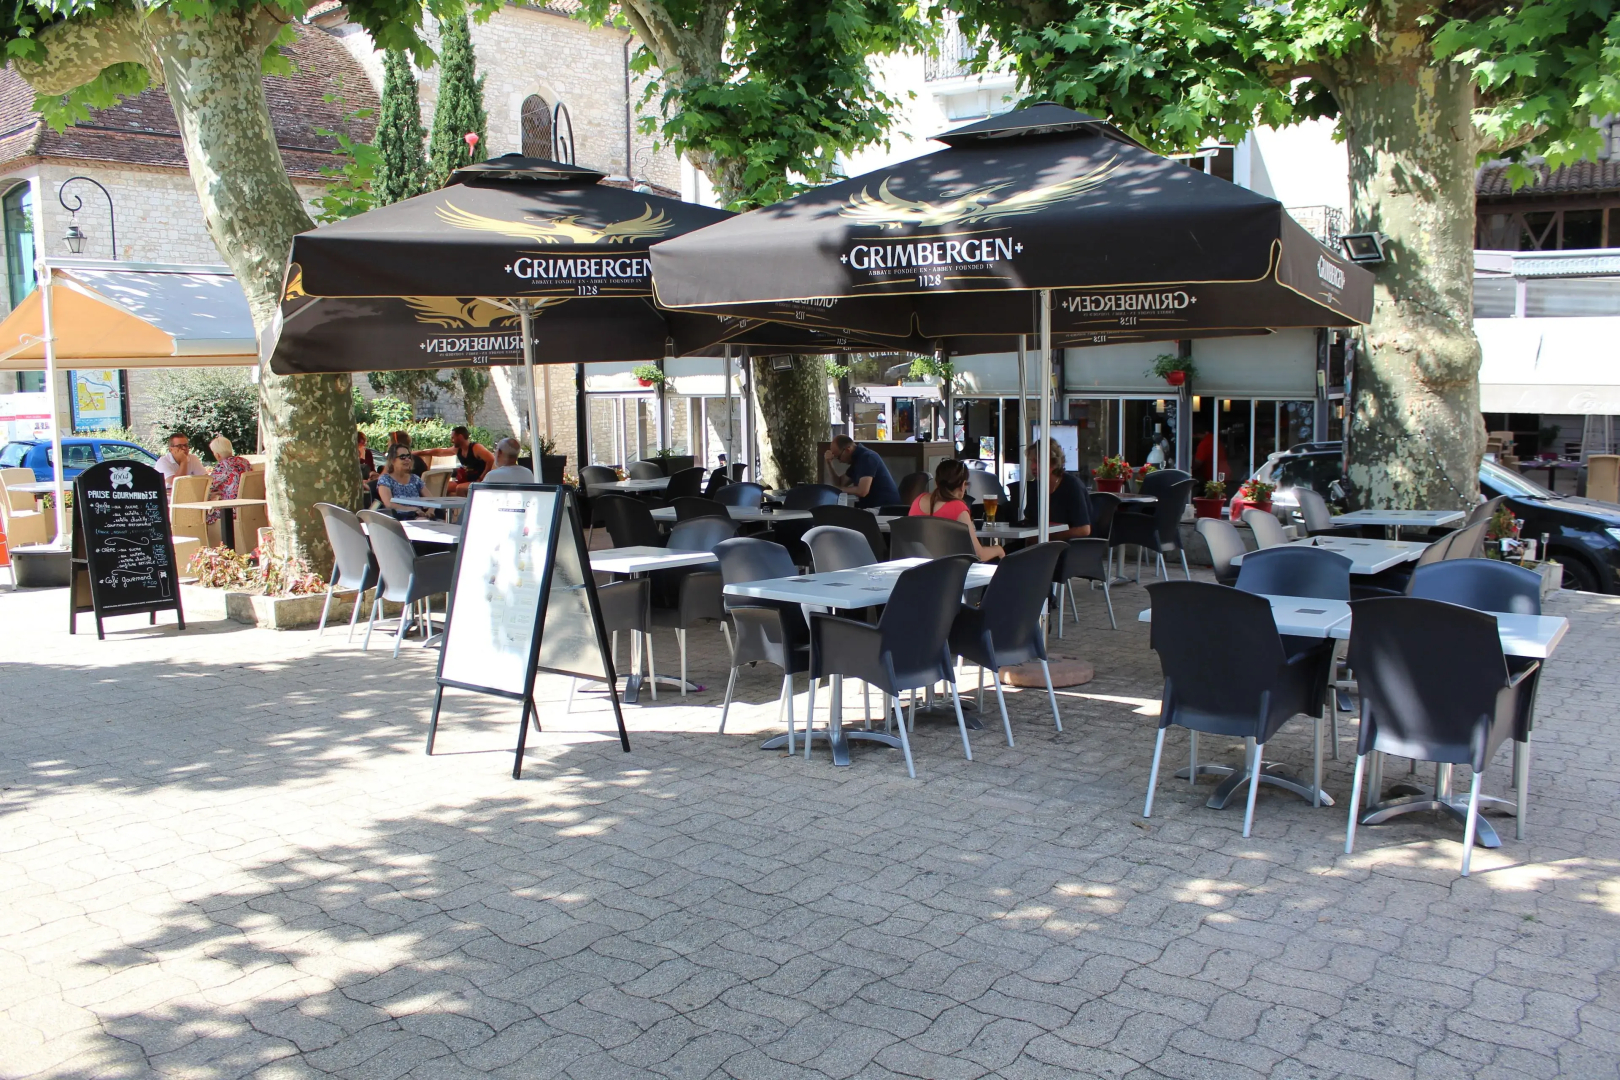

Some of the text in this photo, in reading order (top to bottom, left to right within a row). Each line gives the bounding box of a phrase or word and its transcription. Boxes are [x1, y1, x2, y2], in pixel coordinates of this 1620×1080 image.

[850, 236, 1012, 270] GRIMBERGEN
[918, 274, 942, 287] 1128
[578, 286, 598, 295] 1128
[88, 490, 110, 498] PAUSE
